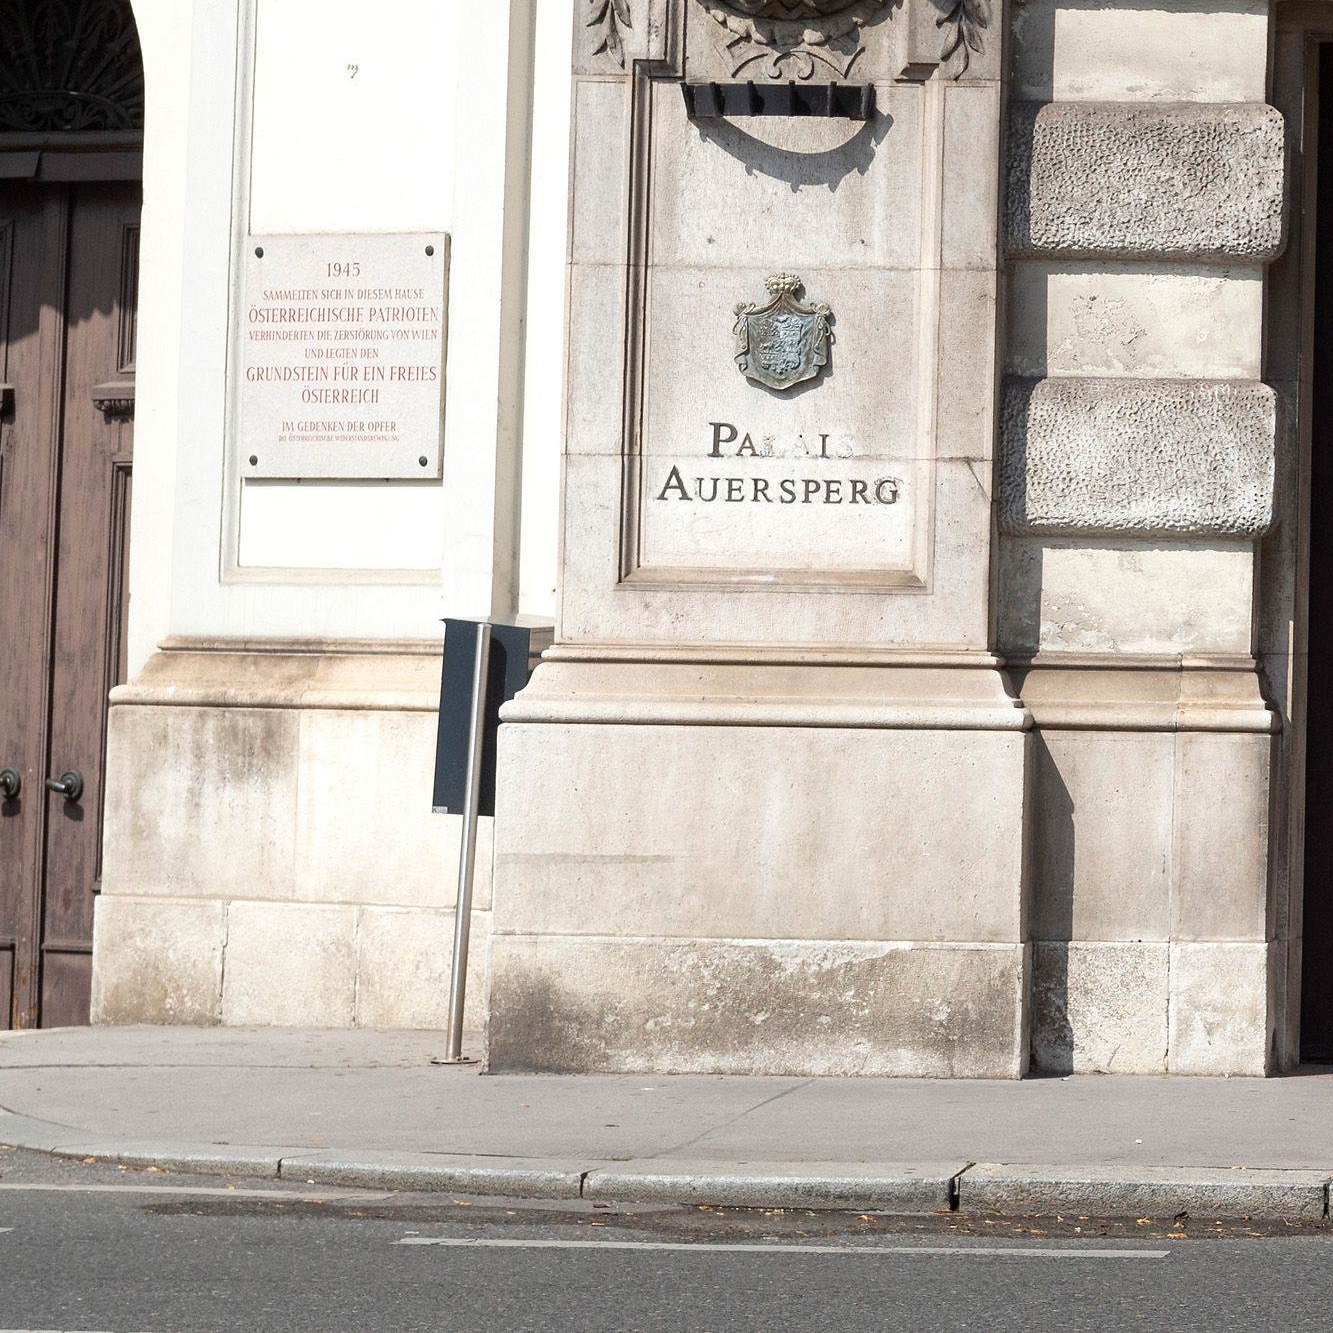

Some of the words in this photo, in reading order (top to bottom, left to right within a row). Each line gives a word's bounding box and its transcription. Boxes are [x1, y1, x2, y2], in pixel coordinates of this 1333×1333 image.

[327, 262, 361, 277] 1945
[263, 289, 319, 301] SAMMELTEN
[321, 289, 342, 300] SICH
[344, 289, 355, 300] IN
[357, 288, 392, 300] DIESEM
[395, 288, 425, 299] HAUSE
[249, 304, 364, 323] ÖSTERREICHISCHE
[368, 307, 439, 322] PATRIOTEN
[249, 330, 315, 341] VERHINDERTEN
[317, 330, 332, 341] DIE
[334, 328, 389, 341] ZERSTÖRUNG
[391, 330, 409, 340] VON
[412, 330, 437, 340] WIEN
[305, 348, 323, 359] UND
[325, 348, 358, 359] LEGTEN
[360, 348, 379, 359] DEN
[246, 366, 329, 382] GRUNDSTEIN
[334, 362, 359, 381] FÜR
[363, 366, 385, 381] EIN
[390, 366, 437, 381] FREIES
[301, 385, 379, 404] ÖSTERREICH
[282, 421, 294, 432] IM
[297, 421, 345, 432] GEDENKEN
[347, 421, 365, 432] DER
[367, 421, 396, 432] OPFER
[707, 422, 853, 459] PAIS
[656, 464, 900, 505] AUERSPERG
